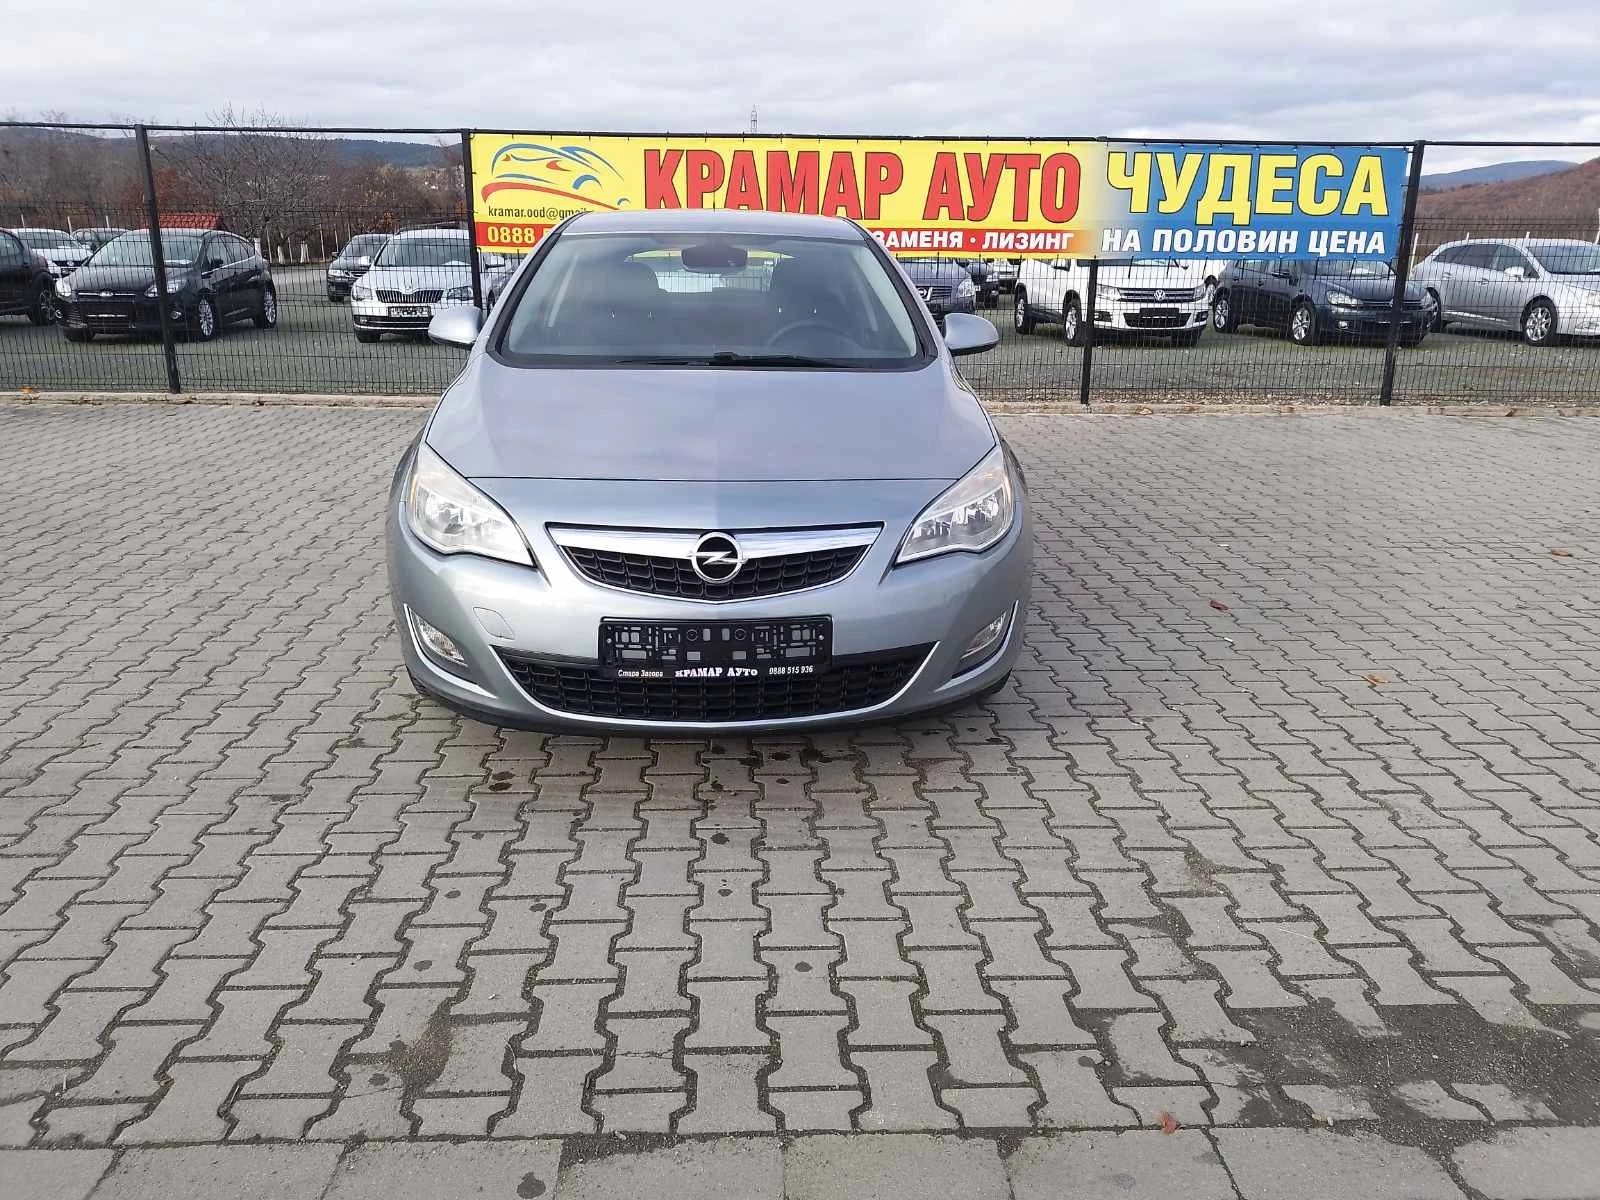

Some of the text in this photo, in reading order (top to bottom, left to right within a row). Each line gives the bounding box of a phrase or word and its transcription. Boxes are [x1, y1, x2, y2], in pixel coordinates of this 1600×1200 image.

[643, 148, 1082, 224] КРАМАР АУТО
[1106, 151, 1389, 226] ЧУДЕСА
[487, 226, 536, 244] 0888
[982, 232, 1074, 250] ЛИЗИНГ
[1101, 228, 1387, 258] НА ПОЛОВИН ЦЕНА
[674, 667, 723, 678] КРАМАР
[768, 664, 814, 675] 0888 515 936
